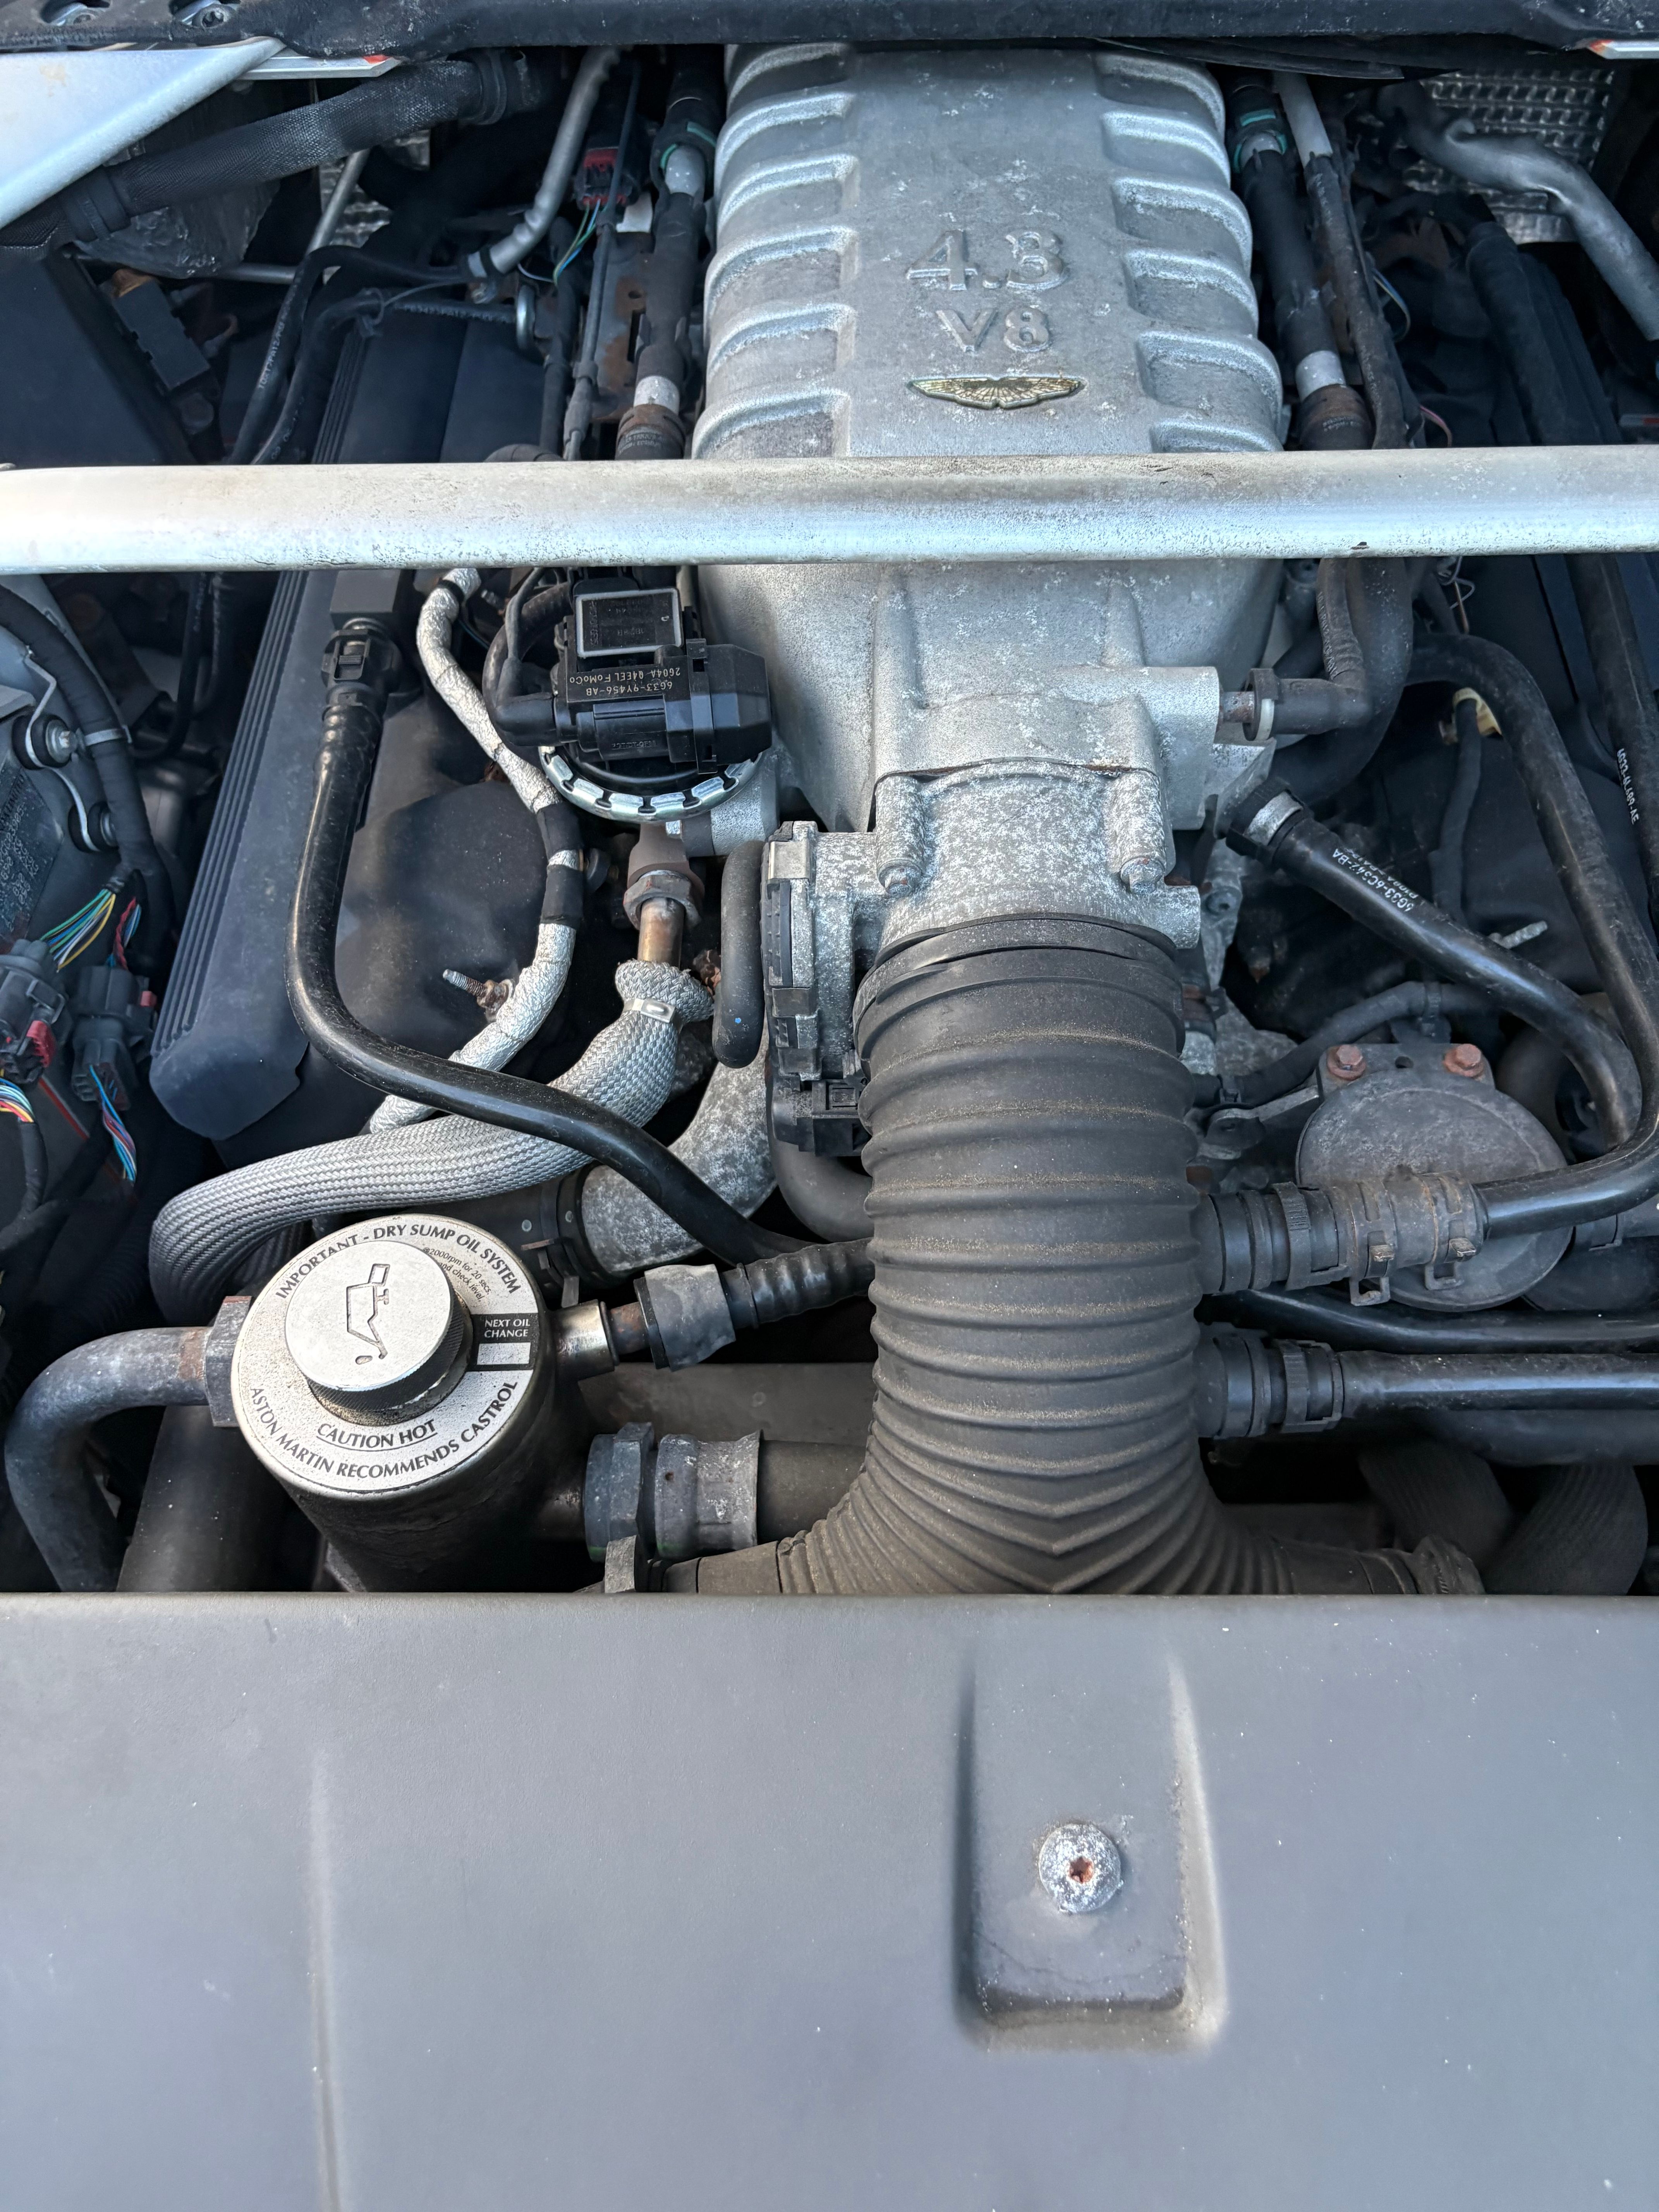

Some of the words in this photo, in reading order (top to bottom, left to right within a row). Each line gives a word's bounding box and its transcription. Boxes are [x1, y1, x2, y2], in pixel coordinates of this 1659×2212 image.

[907, 231, 1068, 290] 4.3
[936, 309, 1051, 352] V8
[570, 674, 611, 684] FoMoCo
[586, 682, 672, 696] 6G33-9Y456-AB
[276, 1233, 360, 1300] IMPORTANT
[374, 1224, 407, 1240] DRY
[410, 1224, 456, 1240] SUMP
[457, 1234, 481, 1253] OIL
[480, 1248, 521, 1294] SYSTEM
[452, 1269, 472, 1285] check
[462, 1262, 473, 1272] for
[471, 1270, 482, 1279] 20
[479, 1279, 491, 1295] secs.
[484, 1329, 529, 1338] CHANGE
[485, 1319, 510, 1328] NEXT
[513, 1319, 530, 1327] OIL
[251, 1387, 277, 1436] ASTON
[276, 1434, 333, 1473] MARTIN
[337, 1439, 459, 1478] RECOMMENDS
[461, 1379, 518, 1442] CASTROL
[317, 1423, 394, 1448] CAUTION
[399, 1419, 437, 1444] HOT
